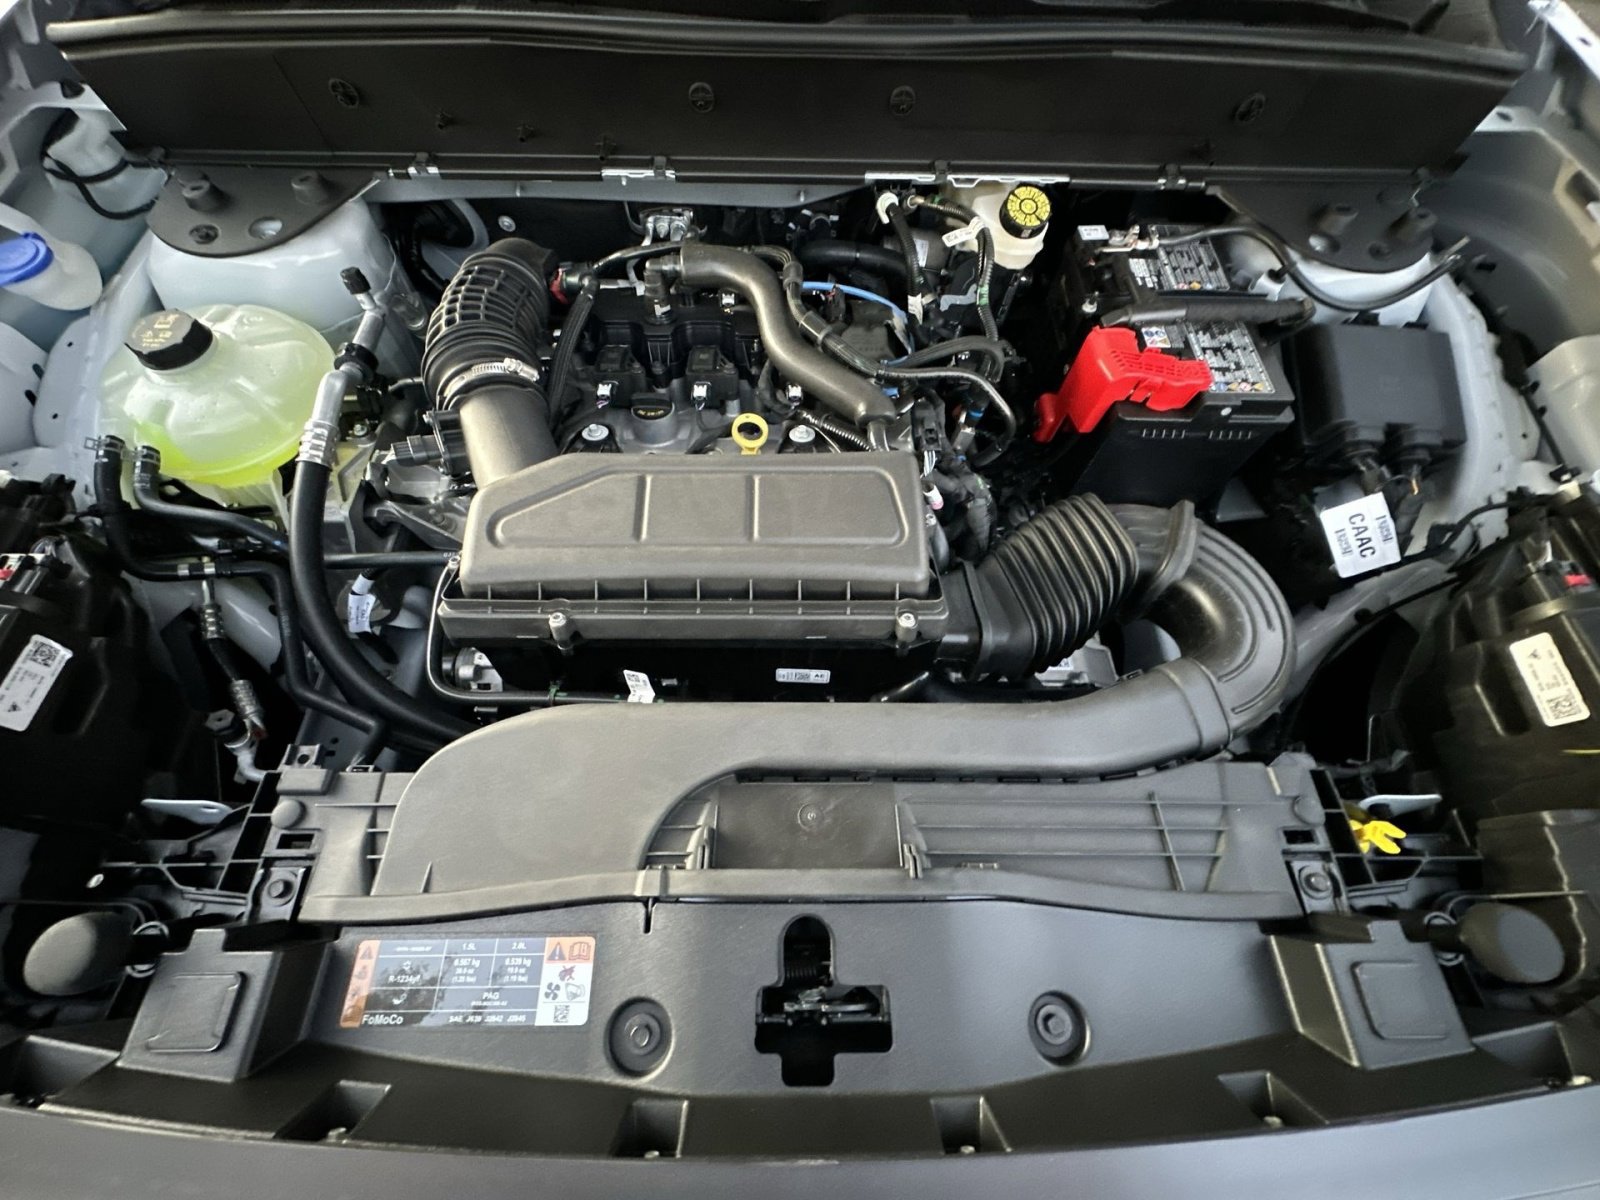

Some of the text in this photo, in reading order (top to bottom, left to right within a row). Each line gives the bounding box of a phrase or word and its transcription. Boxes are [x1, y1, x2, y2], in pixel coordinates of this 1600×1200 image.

[1349, 513, 1376, 558] CAAC
[388, 974, 421, 984] R-1234yf
[482, 992, 500, 1000] PAG
[361, 1014, 404, 1025] FoMoCo
